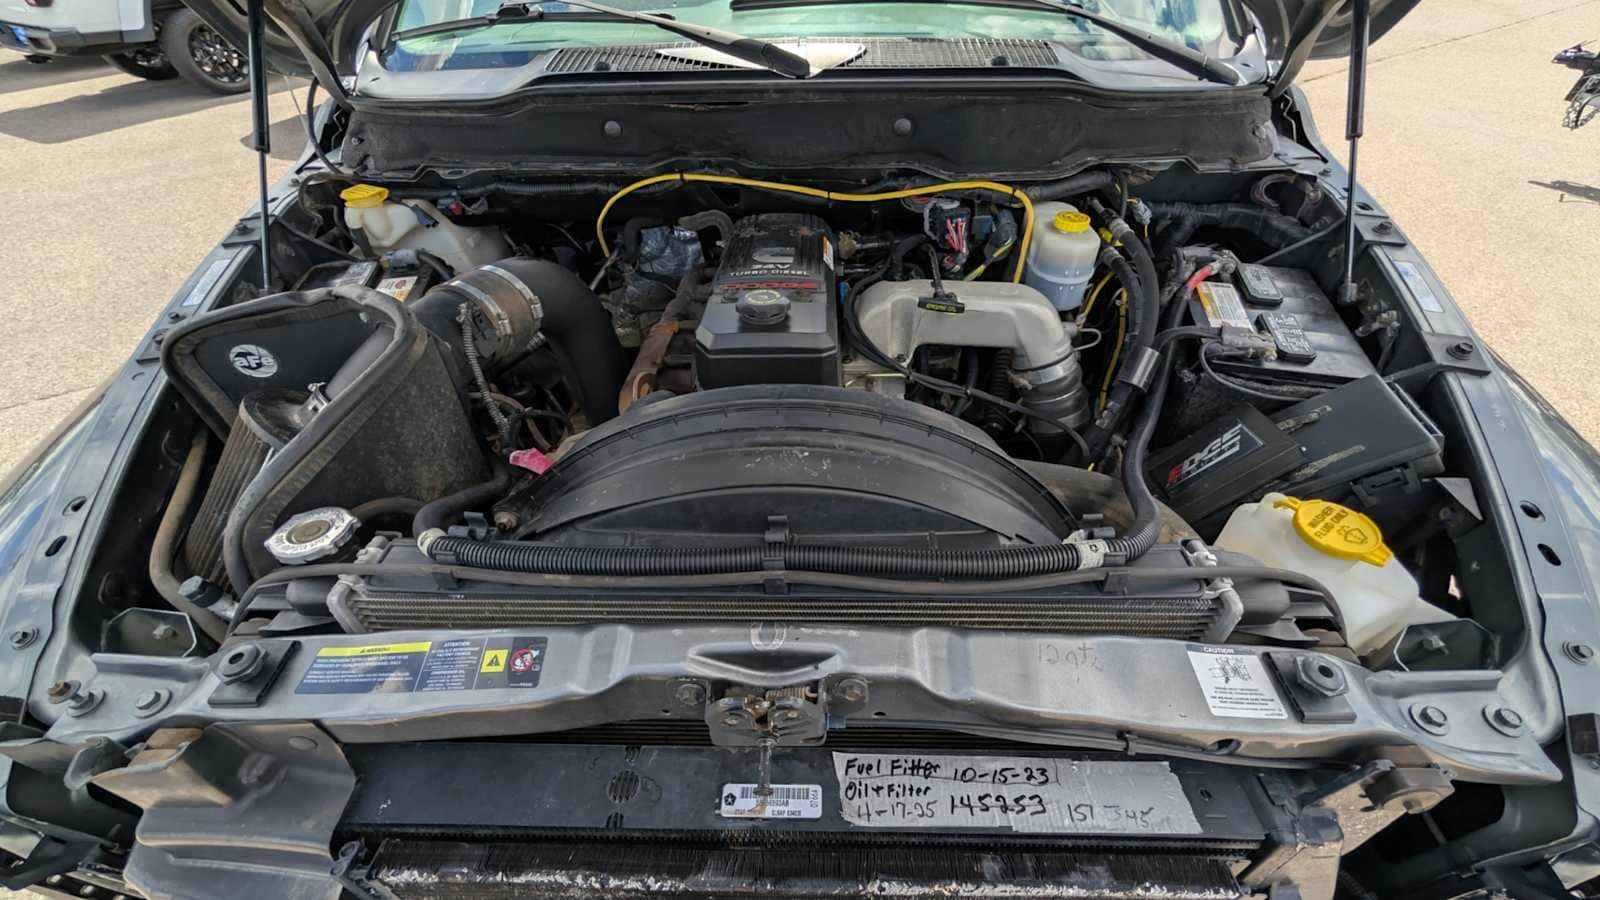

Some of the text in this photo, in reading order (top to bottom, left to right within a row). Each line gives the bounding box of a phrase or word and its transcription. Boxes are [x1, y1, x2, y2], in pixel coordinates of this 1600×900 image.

[730, 268, 811, 277] TURBO DIESEL
[233, 355, 274, 368] aFe
[1313, 521, 1335, 540] FLUID
[1203, 646, 1235, 654] CAUTION
[845, 757, 881, 777] Fuel
[953, 766, 1050, 784] 10-15-23
[887, 784, 931, 798] Filter
[950, 793, 1046, 816] 145253
